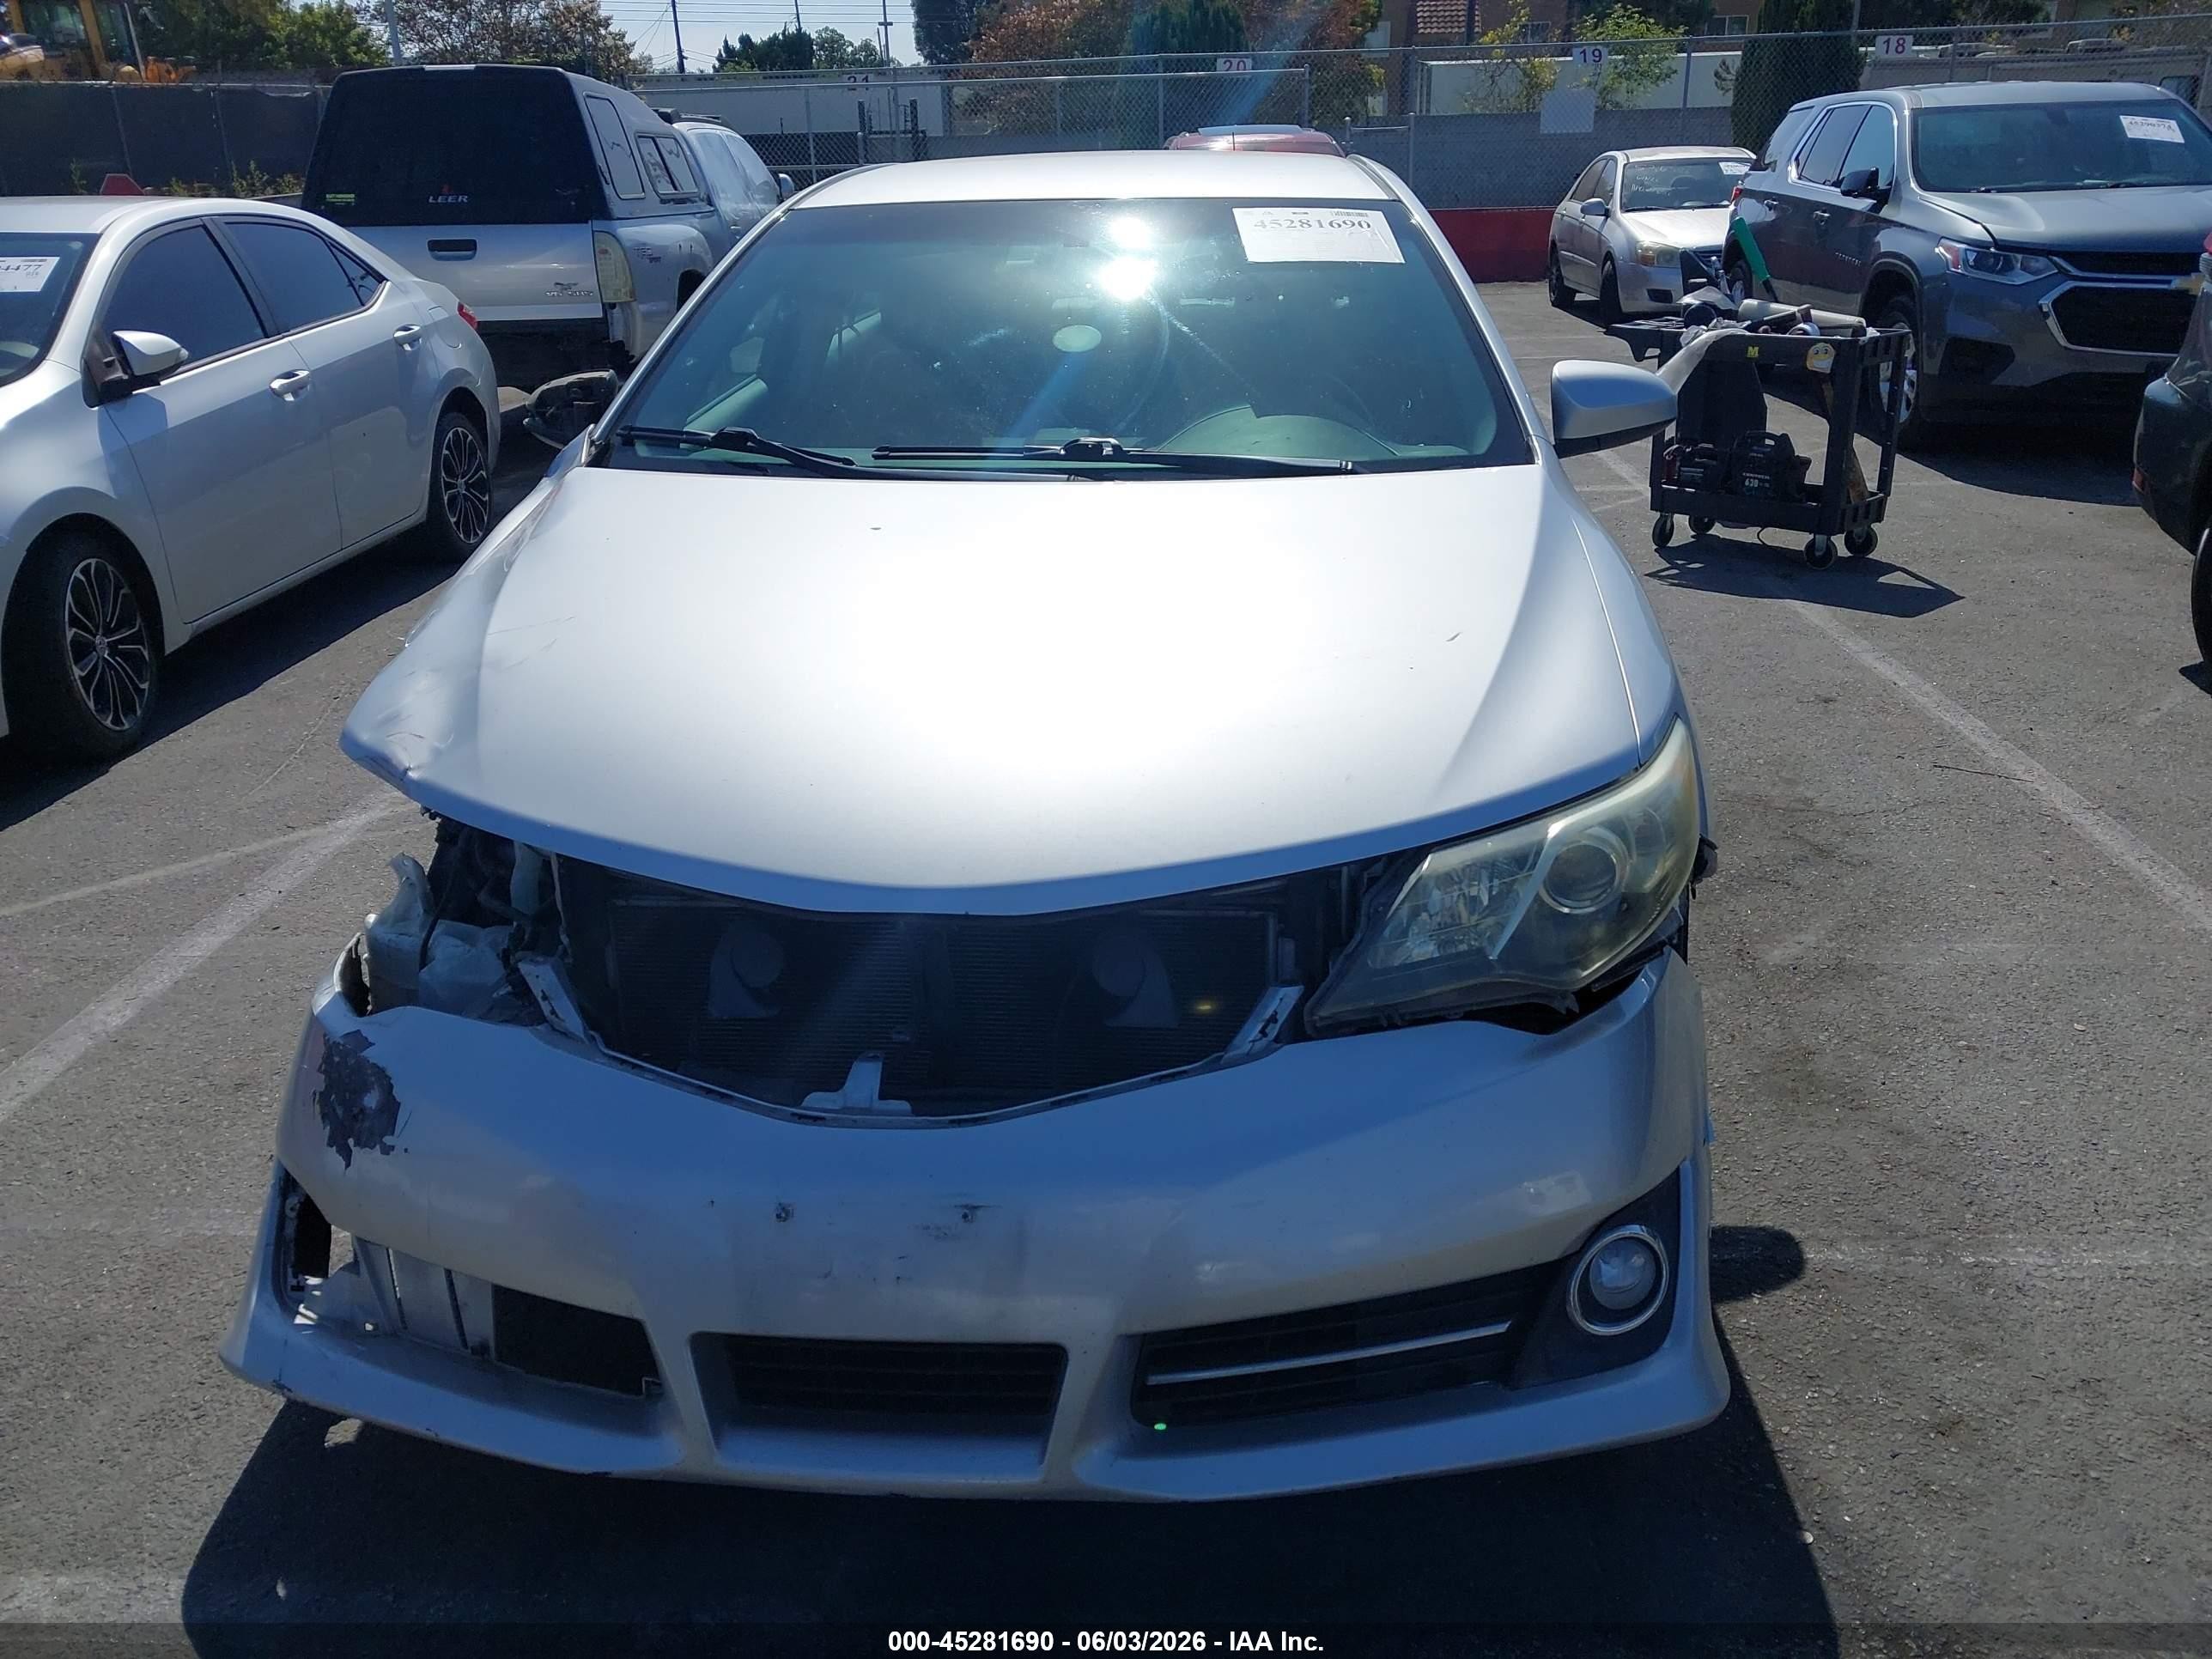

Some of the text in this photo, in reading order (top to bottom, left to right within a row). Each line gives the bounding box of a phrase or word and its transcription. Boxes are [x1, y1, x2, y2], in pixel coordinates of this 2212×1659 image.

[1883, 37, 1905, 55] 18
[1580, 48, 1602, 64] 19
[1223, 59, 1247, 71] 20
[1254, 218, 1371, 229] 45281690
